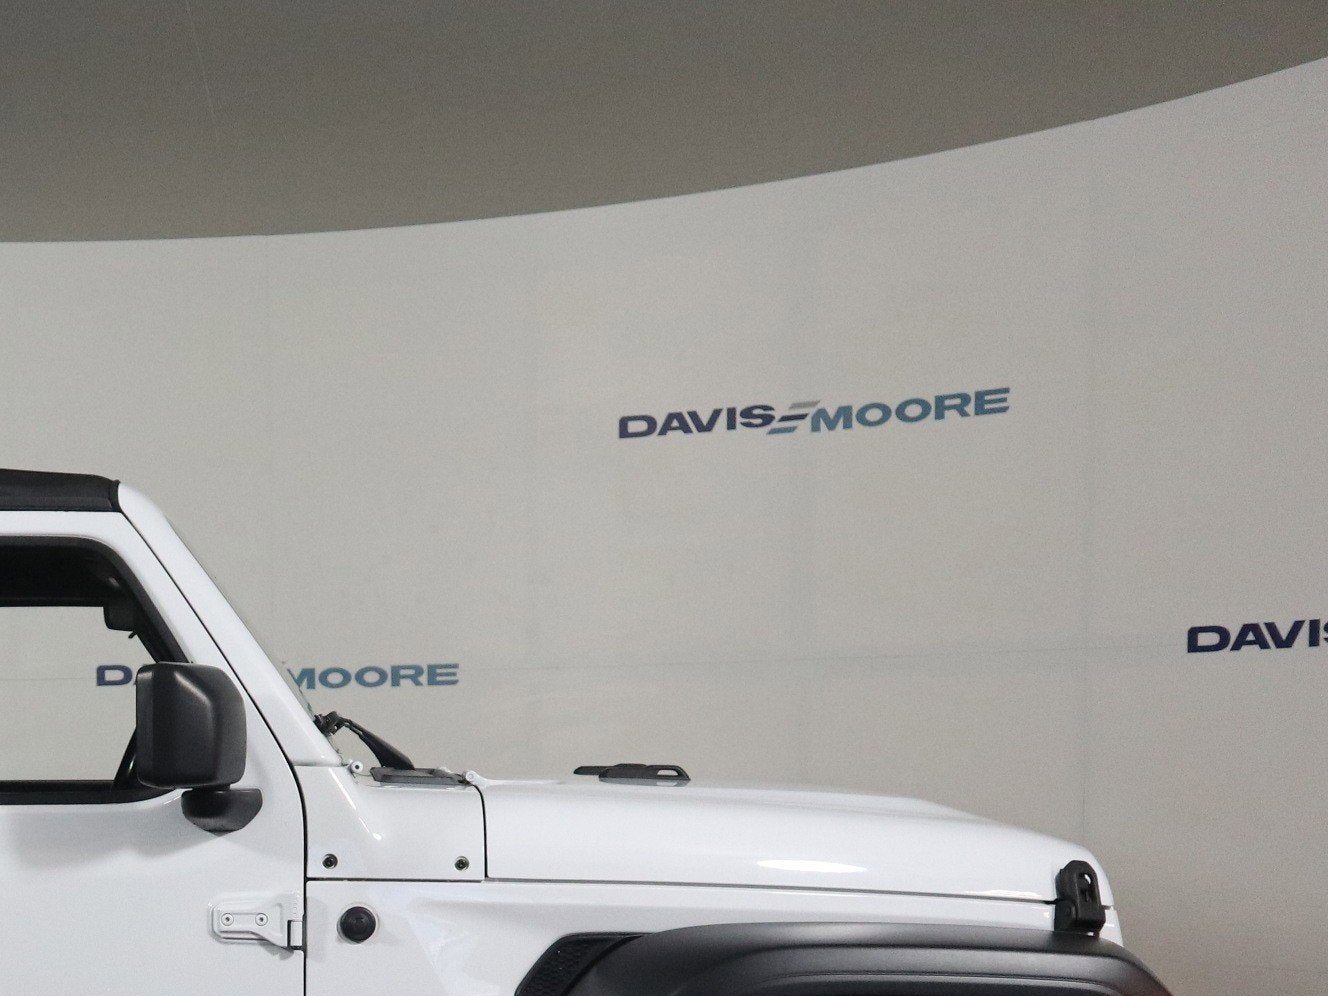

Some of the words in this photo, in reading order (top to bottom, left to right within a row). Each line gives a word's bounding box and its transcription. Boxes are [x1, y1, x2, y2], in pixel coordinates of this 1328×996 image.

[618, 404, 776, 439] DAVIS
[810, 386, 1011, 433] MOORE
[1186, 618, 1328, 654] DAVI
